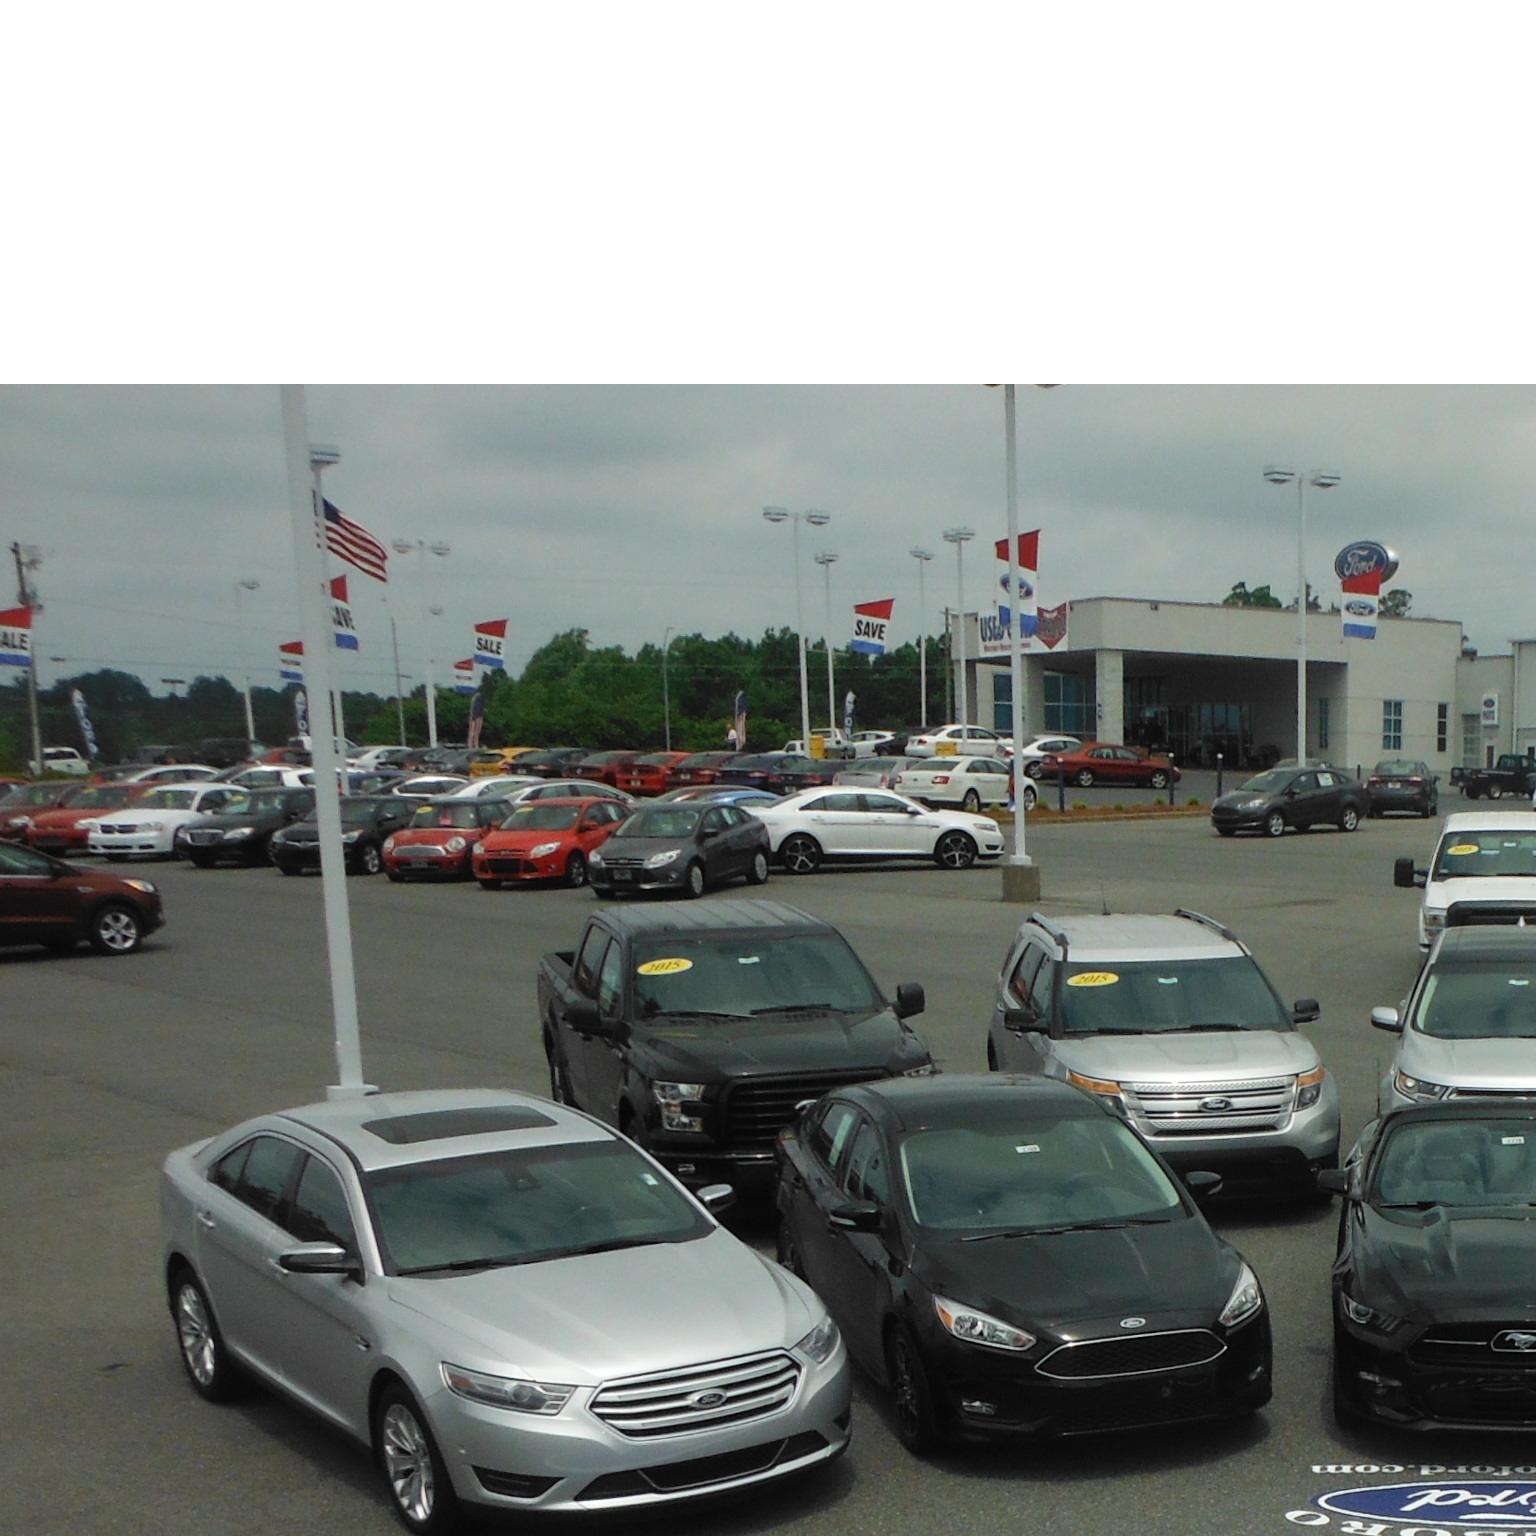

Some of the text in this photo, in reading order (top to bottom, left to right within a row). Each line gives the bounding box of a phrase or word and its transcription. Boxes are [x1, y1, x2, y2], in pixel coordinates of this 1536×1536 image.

[1344, 549, 1378, 577] Ford
[854, 619, 886, 640] SAVE
[0, 631, 28, 650] ALE
[476, 636, 503, 655] SALE
